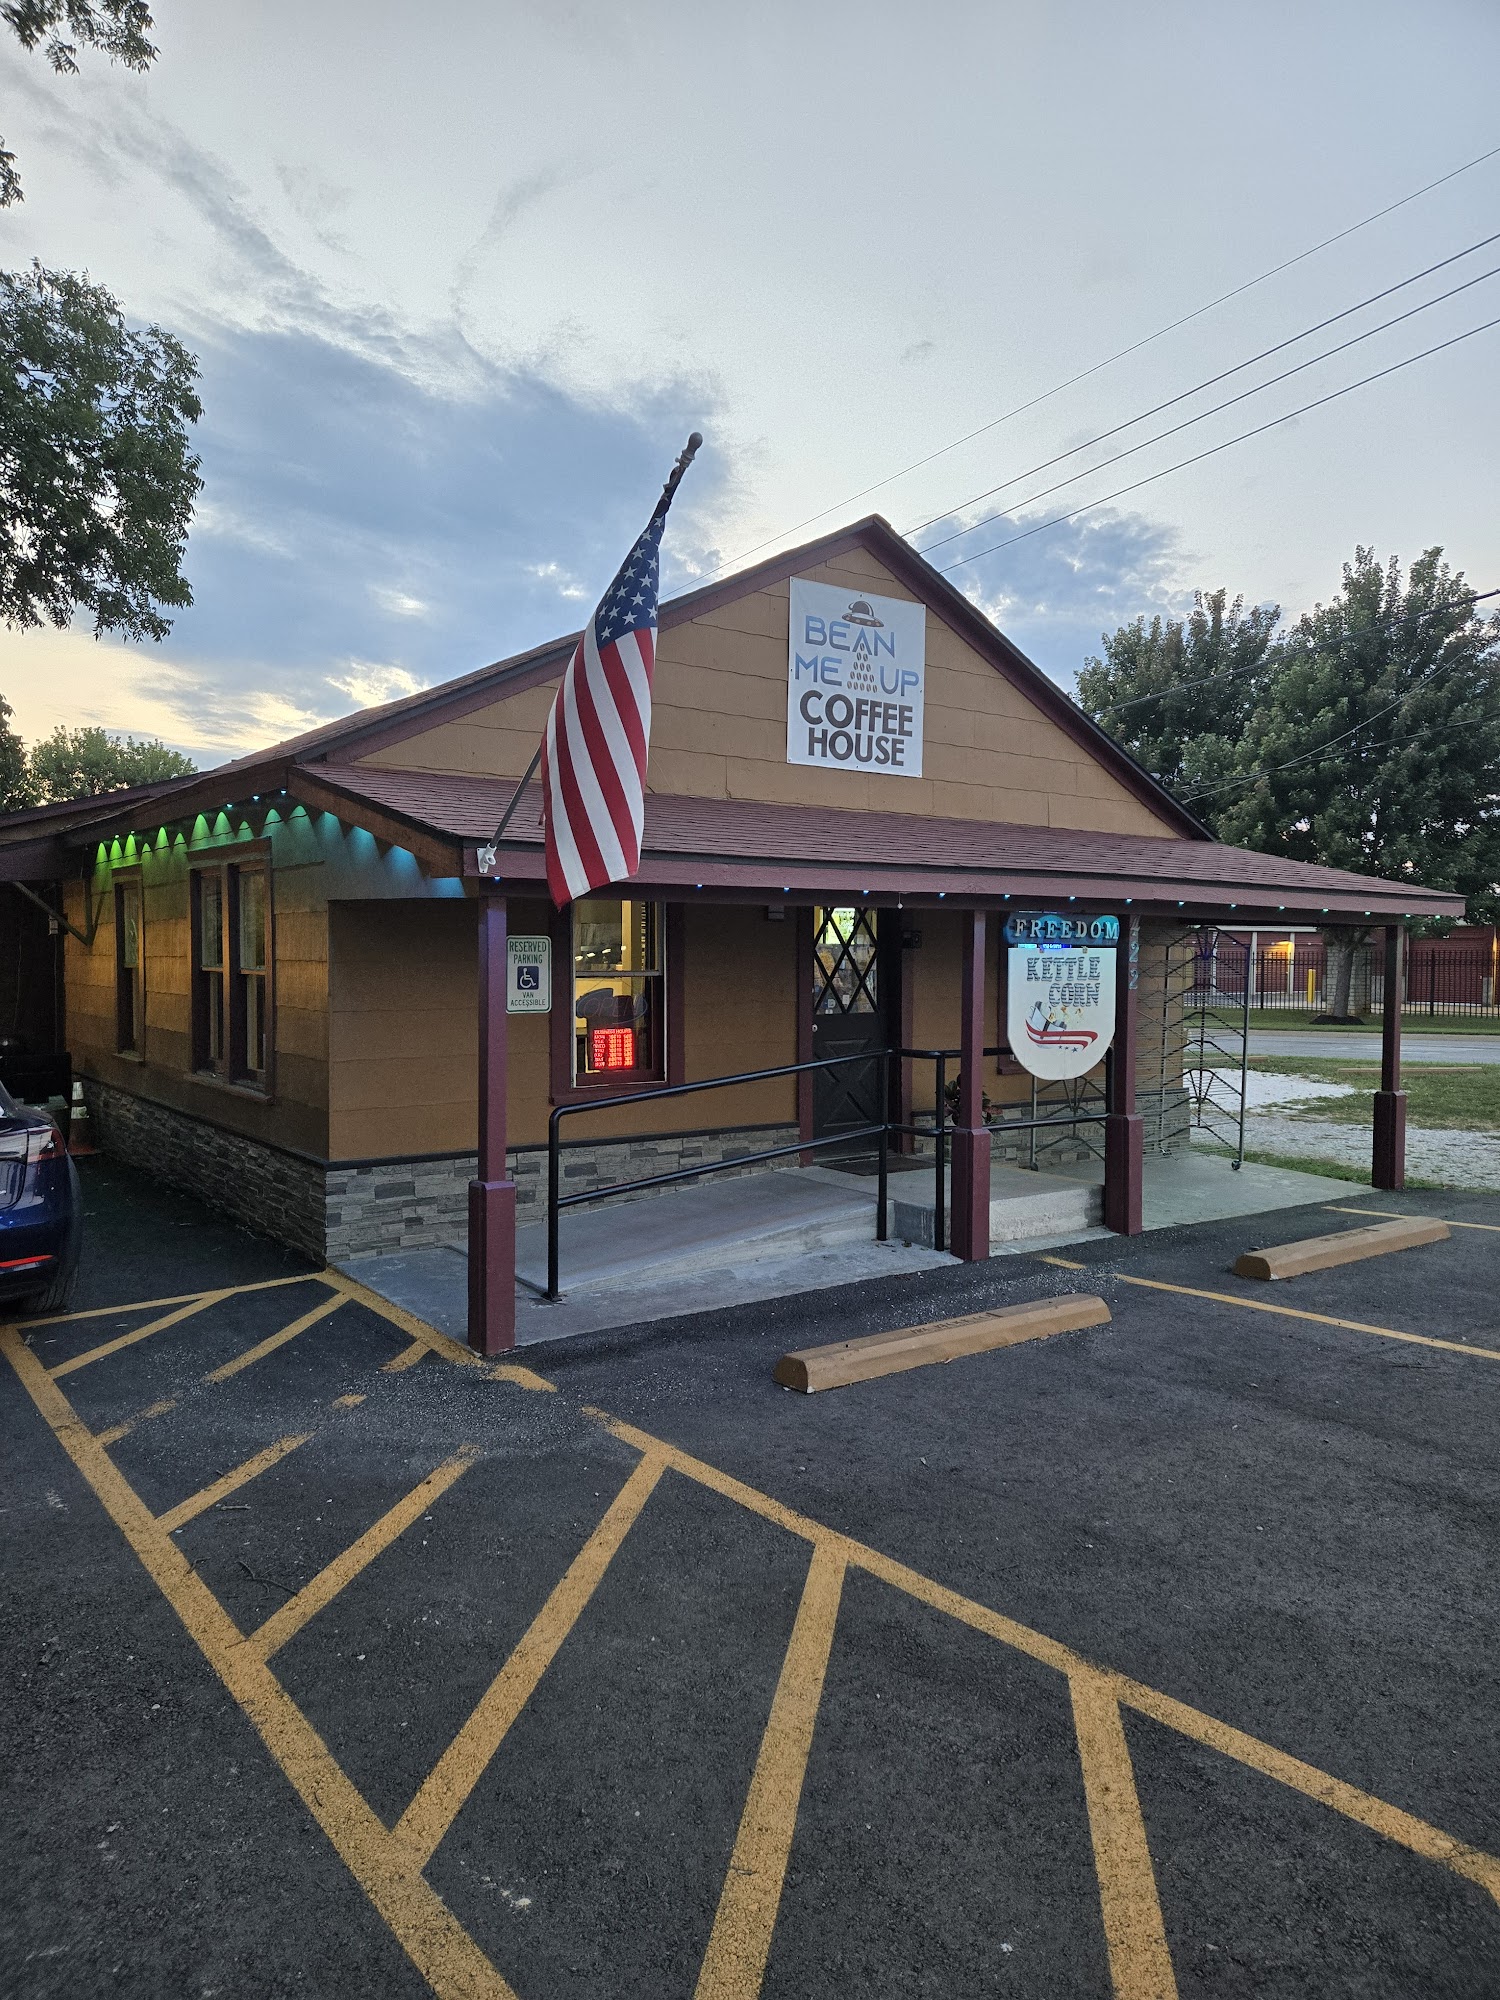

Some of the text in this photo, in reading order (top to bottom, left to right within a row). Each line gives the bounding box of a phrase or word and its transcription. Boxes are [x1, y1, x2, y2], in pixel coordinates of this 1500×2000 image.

[805, 615, 895, 658] BEAN
[794, 652, 920, 697] ME UP
[800, 690, 913, 738] COFFEE
[808, 727, 905, 767] HOUSE
[1015, 919, 1119, 939] FREEDOM
[509, 941, 547, 953] RESERVED
[513, 954, 543, 964] PARKING
[1026, 956, 1101, 982] KETTLE
[510, 999, 546, 1007] ACCESSIBLE
[584, 997, 641, 1017] OPEN
[1048, 983, 1101, 1007] CORN
